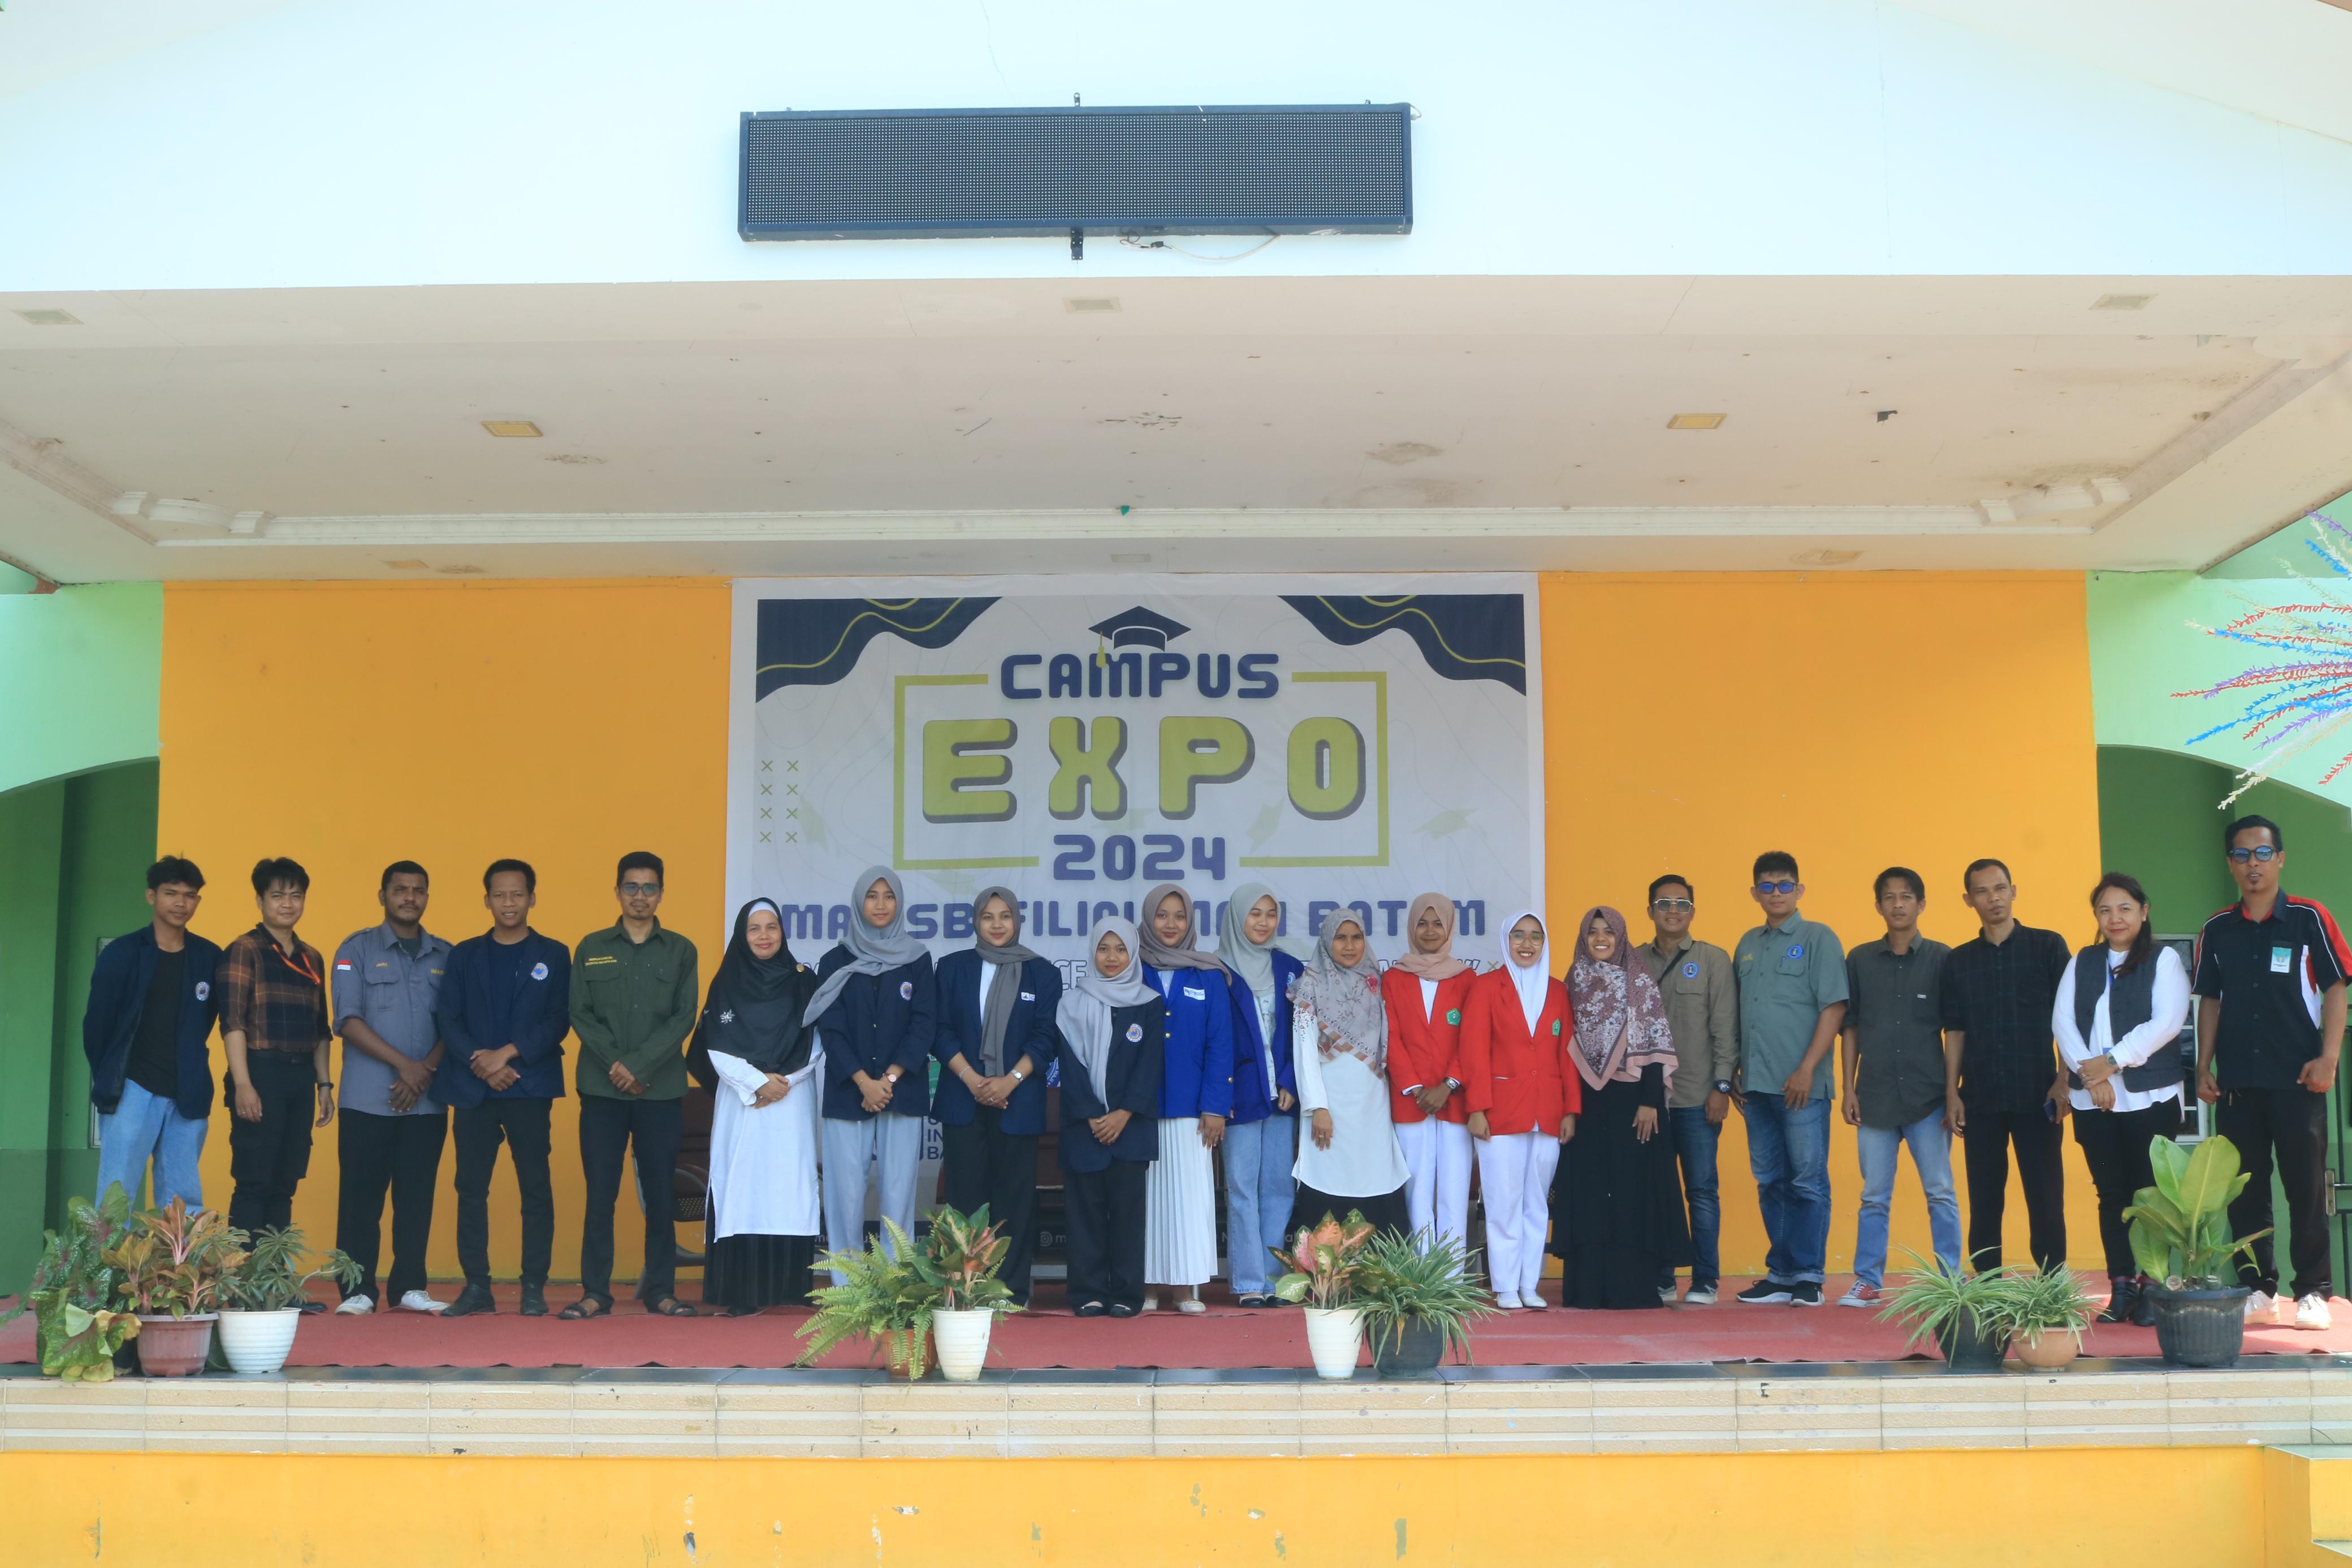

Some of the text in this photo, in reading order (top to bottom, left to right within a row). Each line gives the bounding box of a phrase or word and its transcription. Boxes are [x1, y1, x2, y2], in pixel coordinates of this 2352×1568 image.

[1001, 653, 1279, 699] CAMPUS
[922, 716, 1366, 824] EXPO
[1054, 834, 1225, 881] 2024
